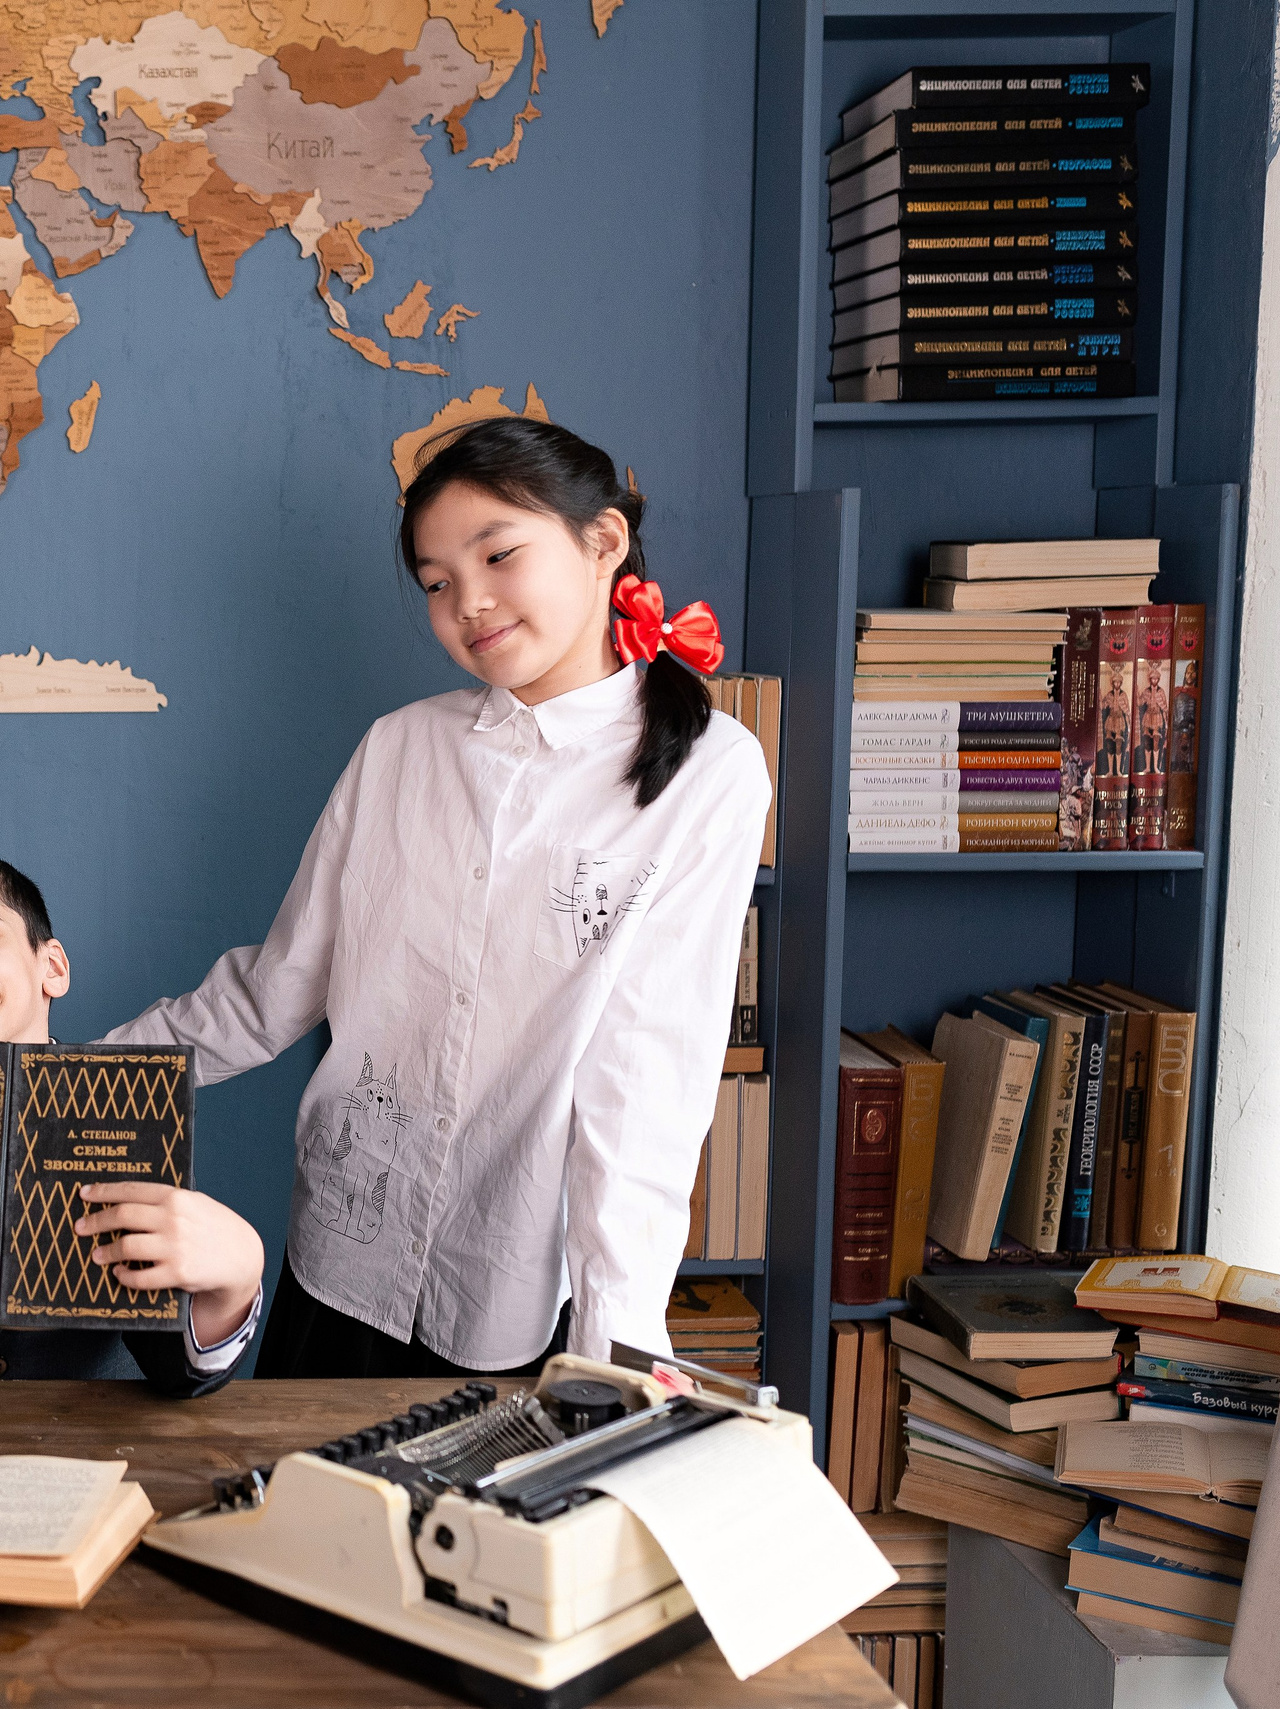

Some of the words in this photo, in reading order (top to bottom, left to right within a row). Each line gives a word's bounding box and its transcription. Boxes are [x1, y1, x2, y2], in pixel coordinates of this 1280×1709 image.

[138, 64, 199, 80] Казахстан
[920, 78, 1002, 91] ЭНЦИКЛОПЕДИЯ
[1007, 78, 1027, 90] ДЛЯ
[1031, 77, 1062, 90] ДЕТЕЙ
[1070, 74, 1109, 83] ИСТОРИЯ
[1070, 84, 1109, 94] РОССИИ
[912, 120, 998, 133] ЭНЦИКЛОПЕДИЯ
[1005, 119, 1025, 131] ДЛЯ
[1030, 117, 1062, 129] ДЕТЕЙ
[1075, 117, 1123, 129] БИОЛОГИЯ
[266, 132, 336, 160] Китай
[908, 163, 991, 175] ЭНЦИКЛОПЕДИЯ
[995, 162, 1015, 173] ДЛЯ
[1019, 159, 1050, 172] ДЕТЕЙ
[1058, 158, 1112, 171] ГЕОГРАФИЯ
[907, 200, 989, 213] ЭНЦИКЛОПЕДИЯ
[993, 199, 1014, 210] ДЛЯ
[1017, 196, 1049, 210] ДЕТЕЙ
[908, 236, 990, 250] ЭНЦИКЛОПЕДИЯ
[994, 236, 1014, 247] ДЛЯ
[1017, 234, 1049, 247] ДЕТЕЙ
[1055, 230, 1105, 240] ВСЕМИРНАЯ
[1055, 241, 1105, 251] ЛИТЕРАТУРА
[907, 272, 989, 285] ЭНЦИКЛОПЕДИЯ
[993, 271, 1013, 282] ДЛЯ
[1017, 268, 1048, 281] ДЕТЕЙ
[1054, 274, 1094, 284] РОССИИ
[907, 306, 989, 318] ЭНЦИКЛОПЕДИЯ
[993, 305, 1013, 316] ДЛЯ
[1017, 302, 1048, 315] ДЕТЕЙ
[1054, 308, 1095, 319] РОССИИ
[915, 340, 1003, 353] ЭНЦИКЛОПЕДИЯ
[1007, 341, 1029, 352] ДЛЯ
[1033, 338, 1067, 351] ДЕТЕЙ
[1078, 334, 1120, 345] РЕЛИГИИ
[948, 367, 1033, 380] ЭНЦИКЛОПЕДИЯ
[1040, 366, 1061, 377] ДЛЯ
[1065, 365, 1098, 377] ДЕТЕЙ
[1054, 381, 1097, 393] ИСТОРИЯ
[857, 713, 909, 722] АЛЕКСАНДР
[909, 713, 938, 722] ДЮМА
[966, 711, 987, 721] ТРИ
[990, 711, 1055, 721] МУШКЕТЕРА
[861, 738, 896, 746] ТОМАС
[900, 738, 931, 746] ГАРДИ
[964, 756, 997, 764] ТЫСЯЧА
[1006, 756, 1030, 765] ОДНА
[1032, 756, 1055, 764] НОЧЬ
[863, 777, 891, 785] ЧАРЛЬЗ
[892, 777, 930, 785] ДИККЕНС
[1005, 777, 1023, 785] ДВУХ
[1025, 777, 1055, 785] ГОРОДАХ
[872, 799, 899, 807] ЖЮЛЬ
[902, 799, 924, 807] ВЕРН
[1104, 800, 1122, 809] РУСЬ
[856, 819, 906, 829] ДАНИЕЛЬ
[909, 818, 936, 829] ДЕФО
[966, 819, 1019, 827] РОБИНЗОН
[1021, 819, 1052, 828] КРУЗО
[966, 838, 1010, 846] ПОСЛЕДНИЙ
[1089, 1042, 1103, 1076] СССР
[1079, 1079, 1100, 1177] ГЕОКРИОЛОГИЯ
[68, 1130, 78, 1140] А.
[81, 1129, 137, 1141] СТЕПАНОВ
[73, 1144, 128, 1157] СЕМЬЯ
[43, 1159, 153, 1174] ЗВОНАРЕВЫХ
[1192, 1391, 1248, 1411] Базовый
[1250, 1403, 1279, 1418] курс
